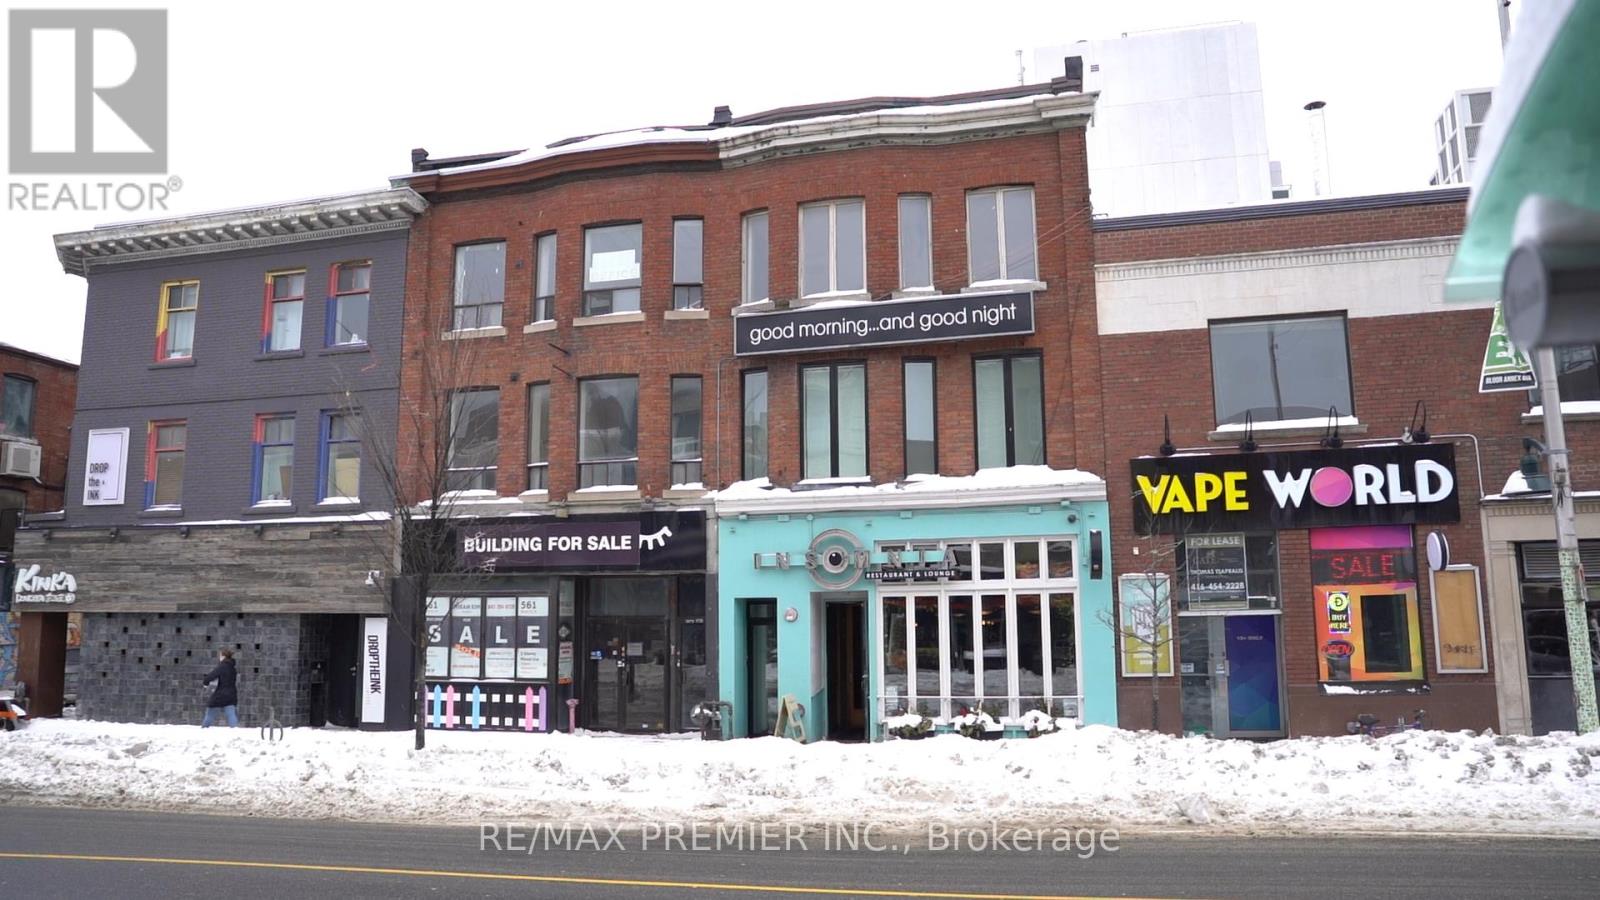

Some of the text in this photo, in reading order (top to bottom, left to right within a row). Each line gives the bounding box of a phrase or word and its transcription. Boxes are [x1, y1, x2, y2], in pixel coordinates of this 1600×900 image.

[749, 321, 795, 345] good
[919, 307, 967, 332] good
[972, 302, 1017, 326] night
[89, 462, 110, 474] DROP
[88, 476, 100, 487] the
[1136, 459, 1454, 515] VAPE WORLD
[87, 489, 100, 500] INK
[464, 535, 632, 553] BUILDING FOR SALE
[1190, 536, 1241, 547] FOR LEASE
[1331, 554, 1395, 579] SALE
[866, 571, 913, 579] RESTAURANT
[924, 569, 956, 577] LOUNGE
[520, 601, 537, 609] 561
[367, 634, 381, 694] DROPTHEINK
